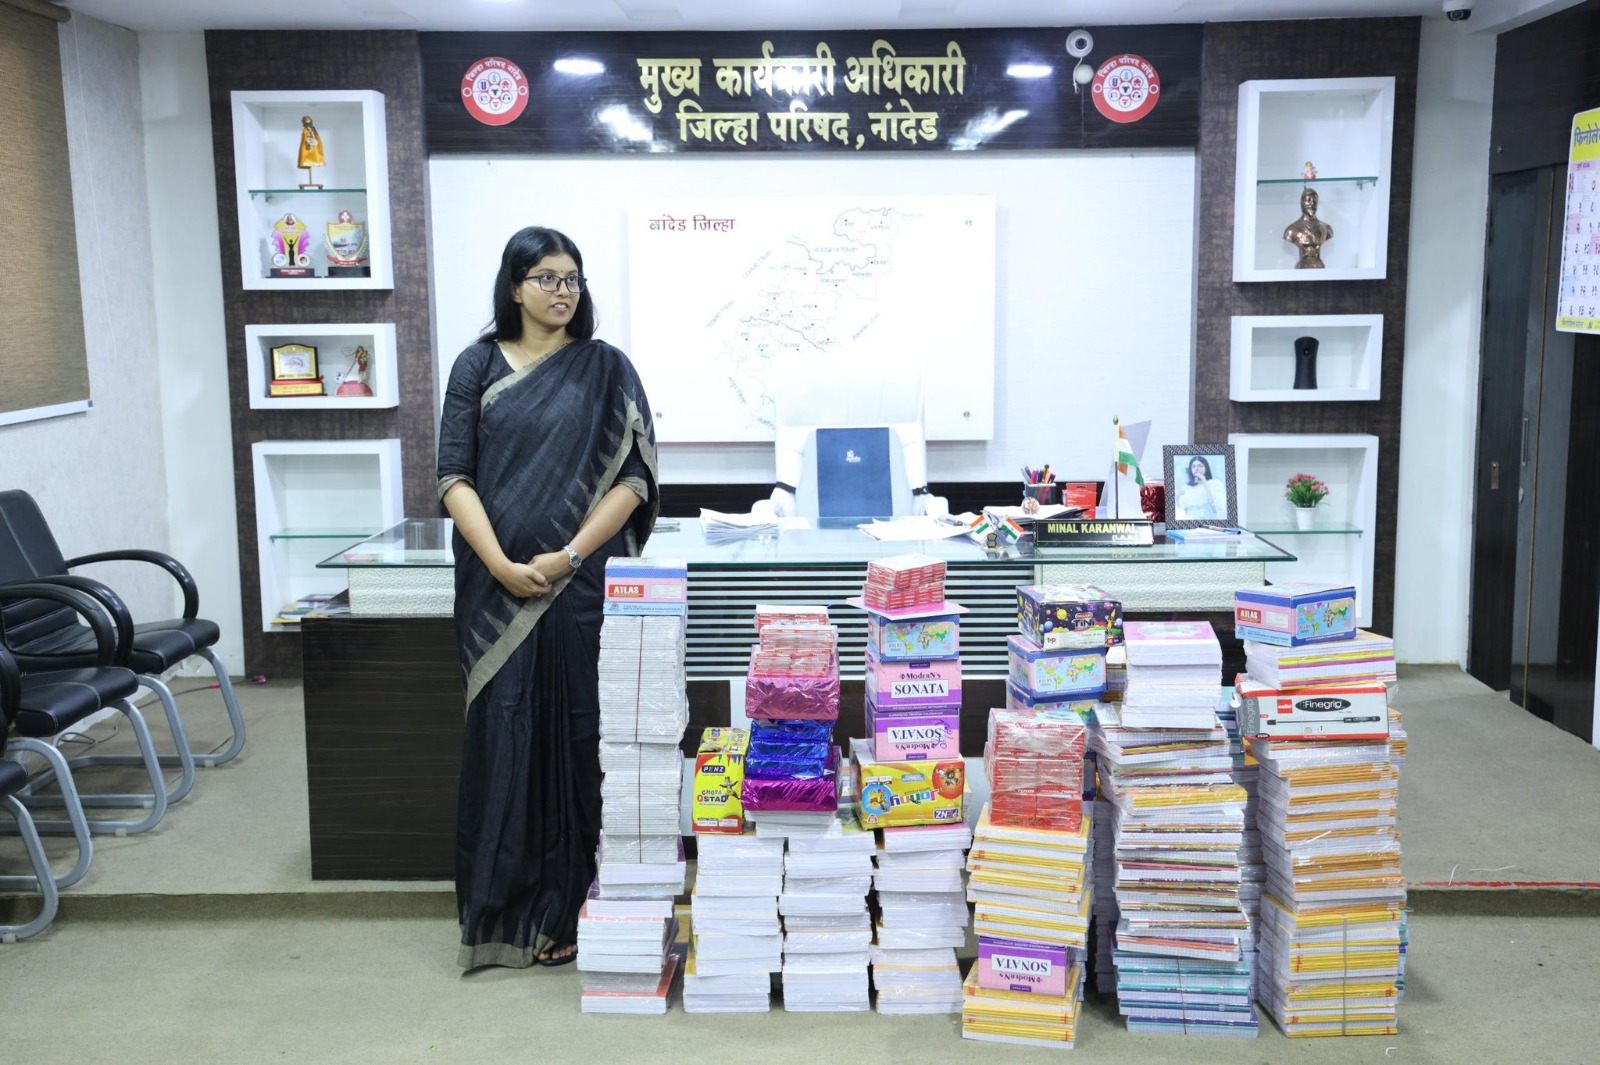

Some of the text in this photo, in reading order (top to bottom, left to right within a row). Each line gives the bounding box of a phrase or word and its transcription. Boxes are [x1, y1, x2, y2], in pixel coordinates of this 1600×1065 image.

[636, 38, 967, 114] मुख्य कार्यकारी अधिकारी
[675, 98, 760, 146] जिल्हा
[868, 98, 939, 145] नांदेड
[1574, 122, 1600, 148] फिनोले
[692, 214, 736, 232] जिल्हा
[1047, 523, 1138, 534] MINAL KARANWAL
[614, 586, 639, 594] ATLAS
[894, 684, 944, 695] SONATA
[1305, 700, 1341, 710] Finegrip
[892, 728, 942, 740] SONATA
[936, 809, 958, 819] PENZ
[996, 958, 1048, 972] SONATA
